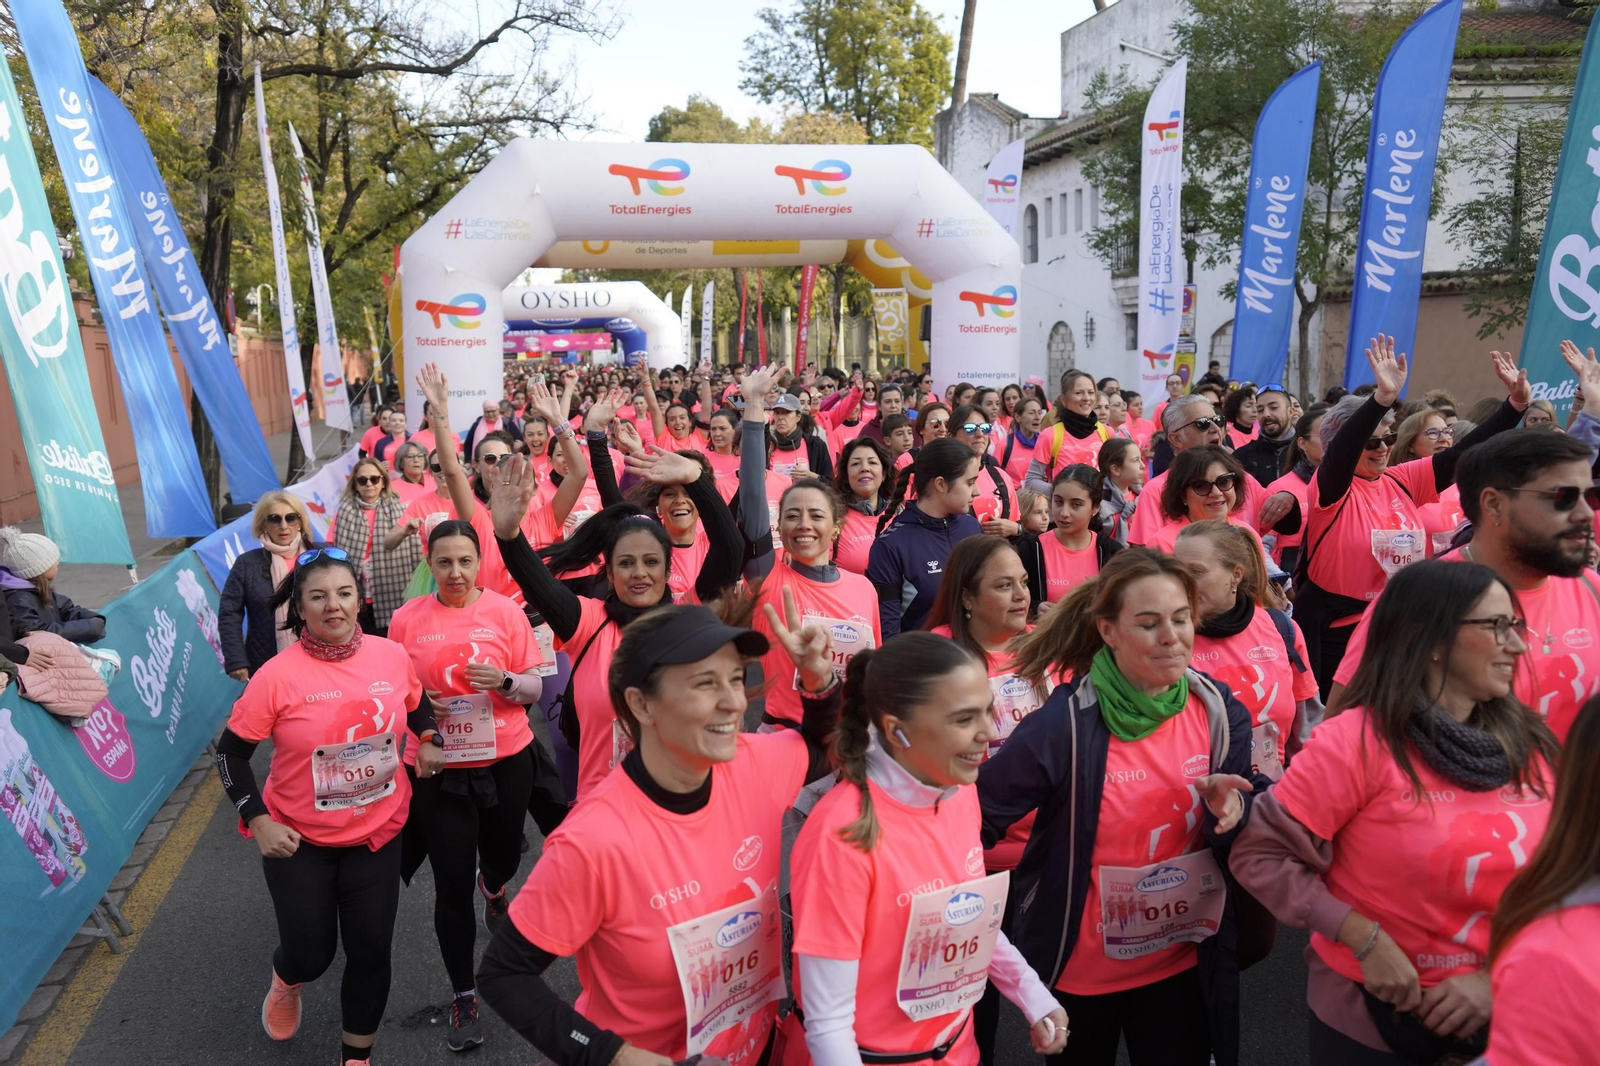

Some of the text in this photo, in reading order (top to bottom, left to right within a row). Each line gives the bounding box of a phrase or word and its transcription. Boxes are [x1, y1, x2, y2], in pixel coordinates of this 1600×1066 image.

[609, 204, 691, 216] TotalEnergies
[775, 204, 852, 216] TotalEnergies
[1363, 128, 1424, 293] Marlene
[635, 246, 688, 256] de Deportes
[1243, 174, 1296, 314] Marlene
[520, 289, 611, 310] OYSHO
[702, 300, 712, 360] YSHO
[959, 324, 1018, 335] TotalEnergies
[415, 336, 487, 349] TotalEnergies
[957, 371, 1017, 380] totalenergies.es
[1392, 554, 1412, 565] 016
[416, 633, 445, 644] OYSHO
[131, 604, 178, 718] Batiste
[1192, 651, 1219, 662] YSHO
[305, 690, 342, 703] OYSHO
[447, 722, 473, 735] 016
[102, 738, 129, 768] ESPAÑA
[343, 765, 376, 782] 016
[1110, 885, 1134, 893] SUMA
[1140, 874, 1185, 890] ASTURIANA
[649, 880, 701, 910] OYSHO
[947, 904, 983, 921] ASTURIANA
[1144, 900, 1189, 921] 016
[919, 916, 942, 927] SUMA
[721, 919, 761, 945] ASTURIANA
[688, 941, 714, 958] SUMA
[943, 935, 979, 963] 016
[1118, 942, 1156, 956] OYSHO
[723, 949, 759, 984] 016
[728, 980, 748, 996] 5882
[915, 986, 940, 998] CARRERA
[909, 998, 945, 1015] OYSHO
